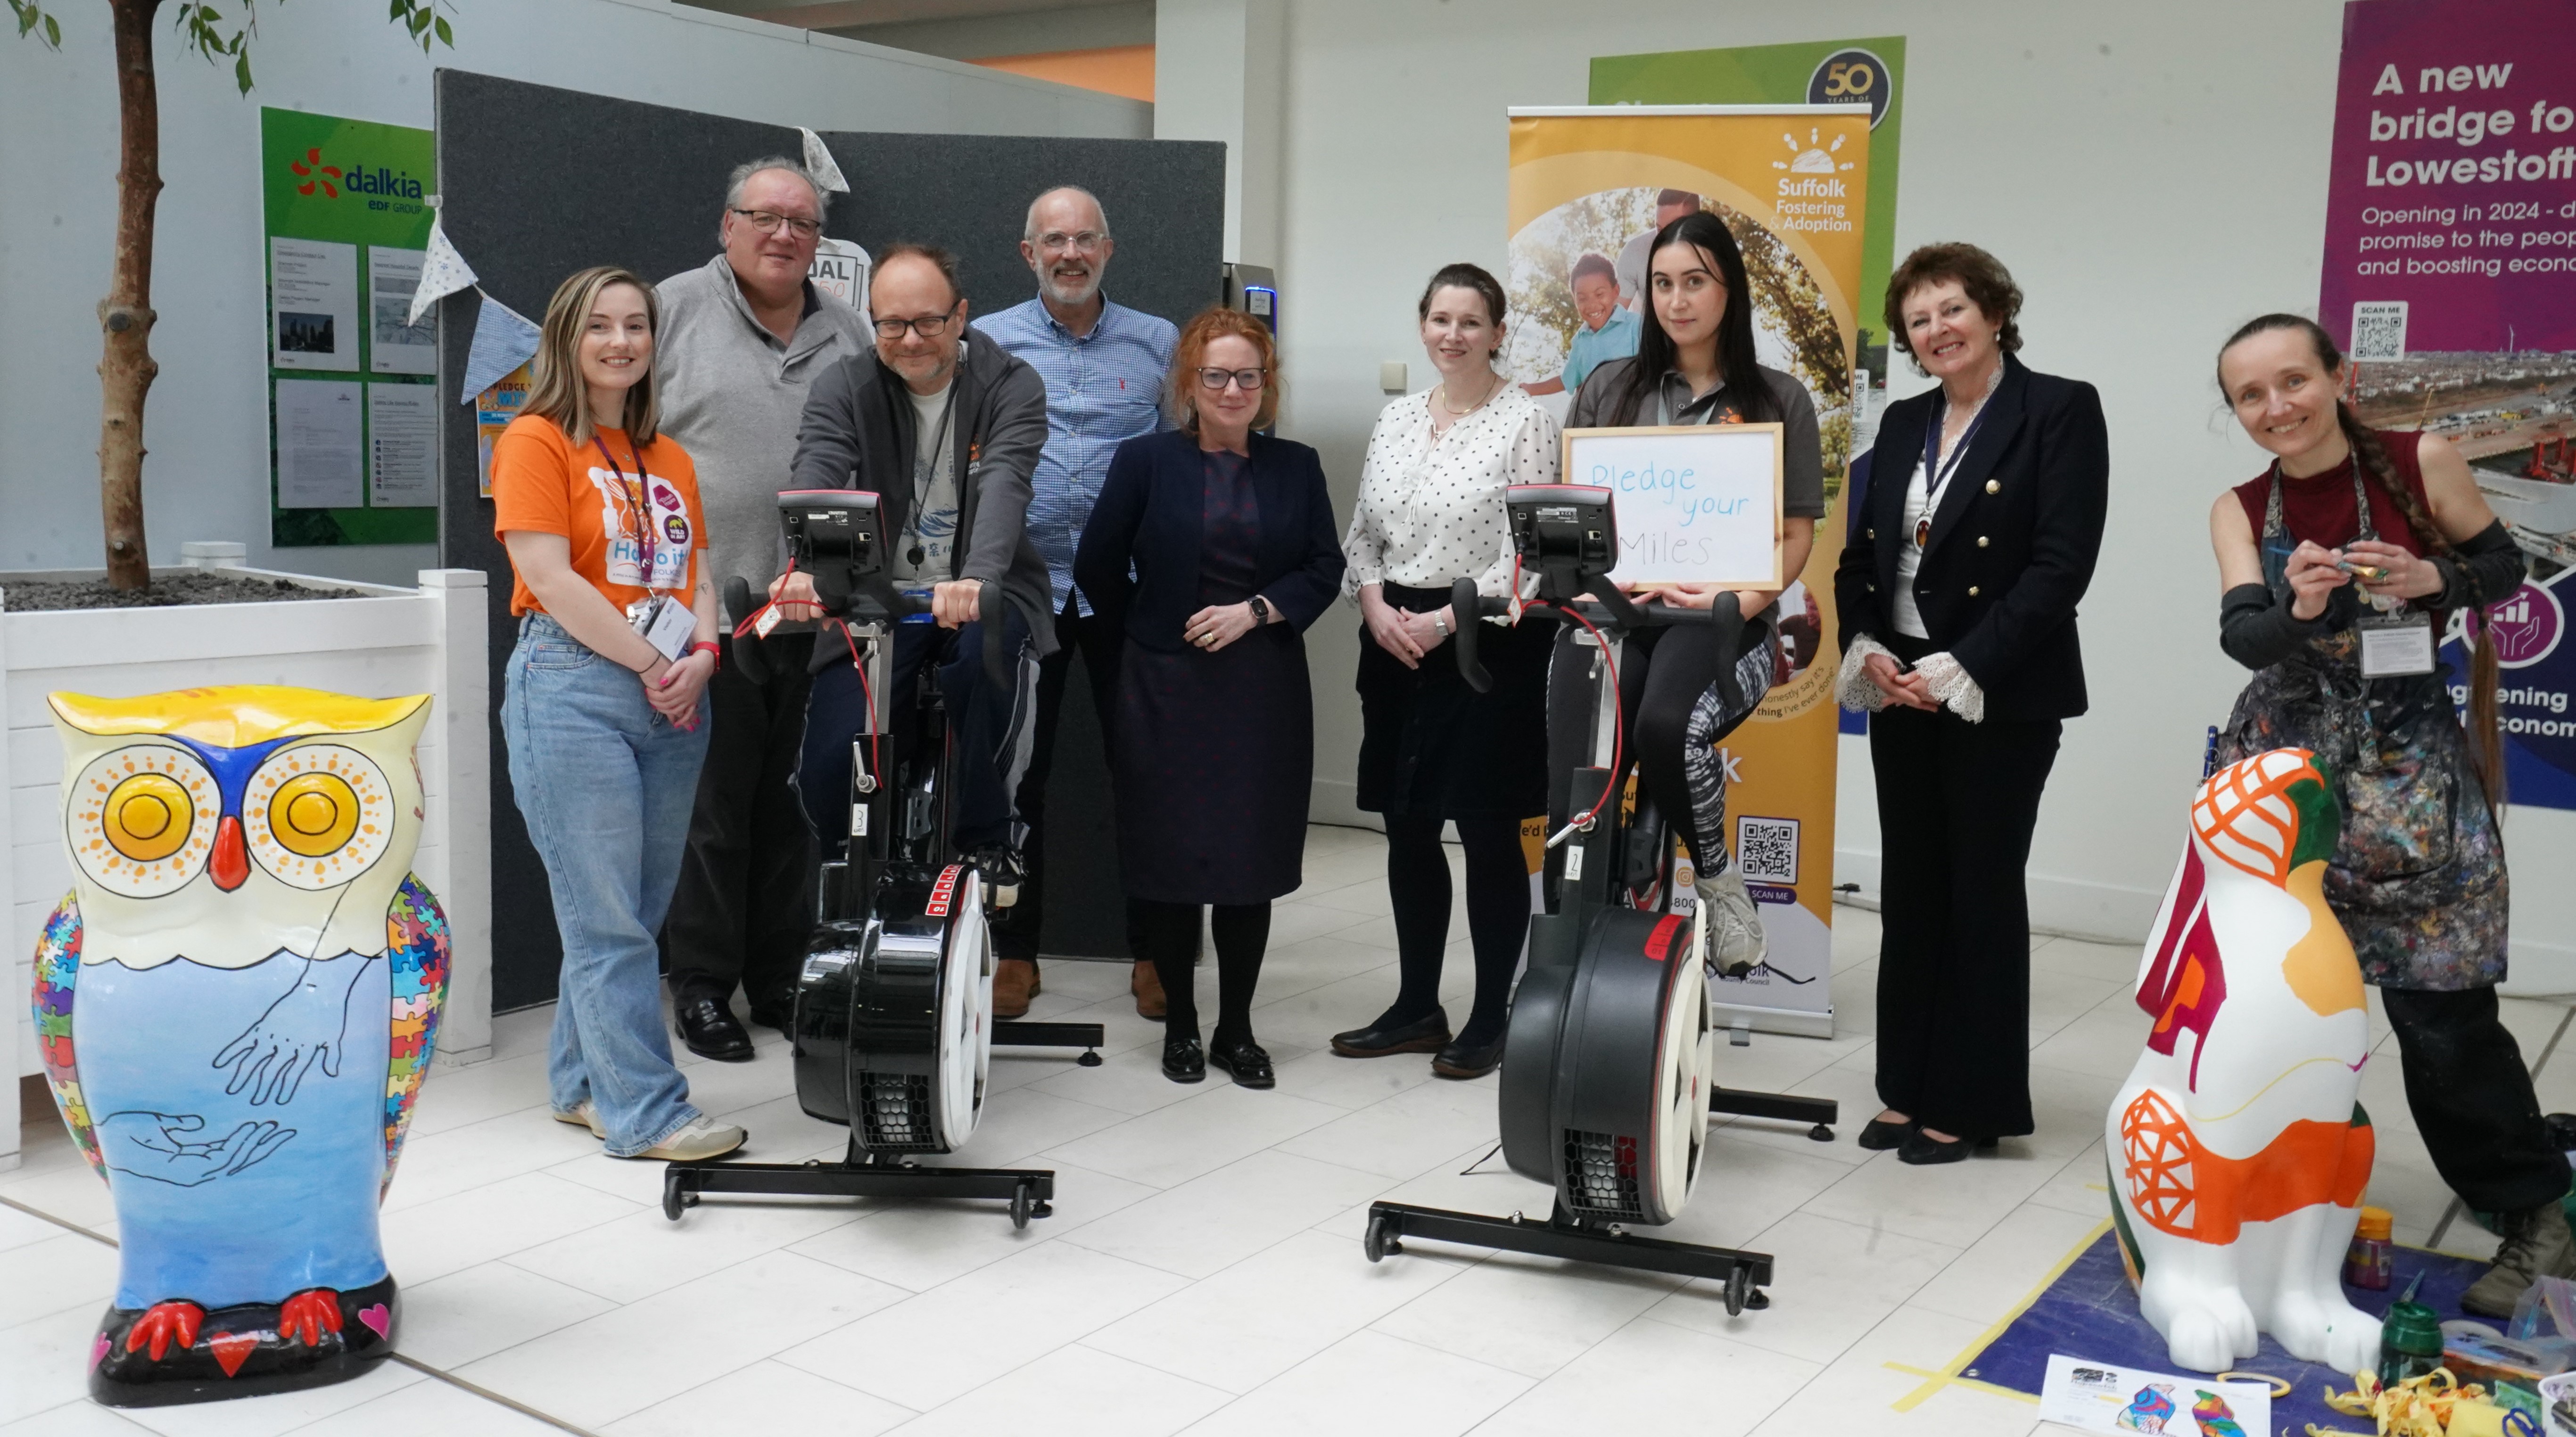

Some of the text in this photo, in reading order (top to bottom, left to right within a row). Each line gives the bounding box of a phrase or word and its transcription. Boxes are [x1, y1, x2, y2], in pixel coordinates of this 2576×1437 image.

[1825, 63, 1874, 96] 50
[2372, 62, 2513, 96] A new
[2370, 100, 2575, 147] bridge fo
[345, 165, 422, 199] dalkia
[1778, 178, 1846, 197] Suffolk
[393, 203, 422, 214] GROUP
[1776, 199, 1845, 219] Fostering
[2362, 205, 2455, 227] Opening
[2463, 205, 2481, 221] in
[2488, 202, 2539, 221] 2024
[2560, 200, 2576, 218] d
[1783, 215, 1852, 233] Adoption
[2360, 231, 2445, 253] promise
[2452, 230, 2472, 247] to
[2479, 230, 2514, 246] the
[2358, 257, 2400, 275] and
[2407, 256, 2501, 278] boosting
[1592, 460, 1696, 504] Pledge
[1679, 495, 1750, 527] your
[614, 542, 639, 562] Ho
[1619, 531, 1713, 566] Miles
[1800, 678, 1815, 692] say
[1757, 707, 1783, 718] thing
[1784, 704, 1800, 714] I've
[1801, 690, 1818, 707] ever
[857, 810, 864, 828] 3
[1571, 853, 1578, 872] 2
[1671, 897, 1696, 909] 800
[1751, 890, 1789, 901] SCAN ME
[1745, 977, 1770, 985] Council
